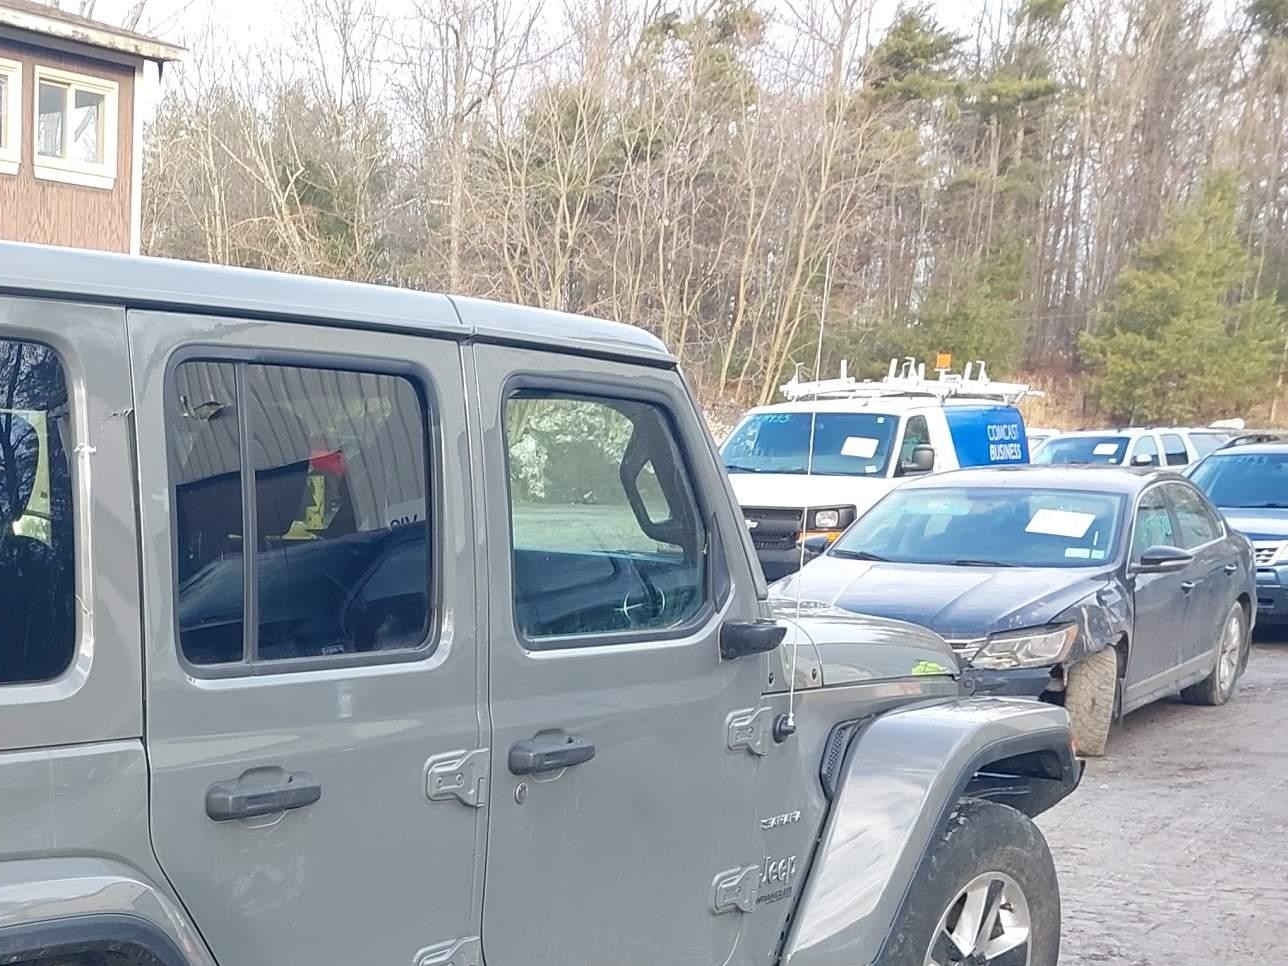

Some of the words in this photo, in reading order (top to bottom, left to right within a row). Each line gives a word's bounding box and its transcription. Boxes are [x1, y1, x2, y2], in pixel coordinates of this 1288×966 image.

[987, 424, 1018, 441] COMCAST
[989, 443, 1022, 461] BUSINESS
[759, 856, 796, 886] Jeep
